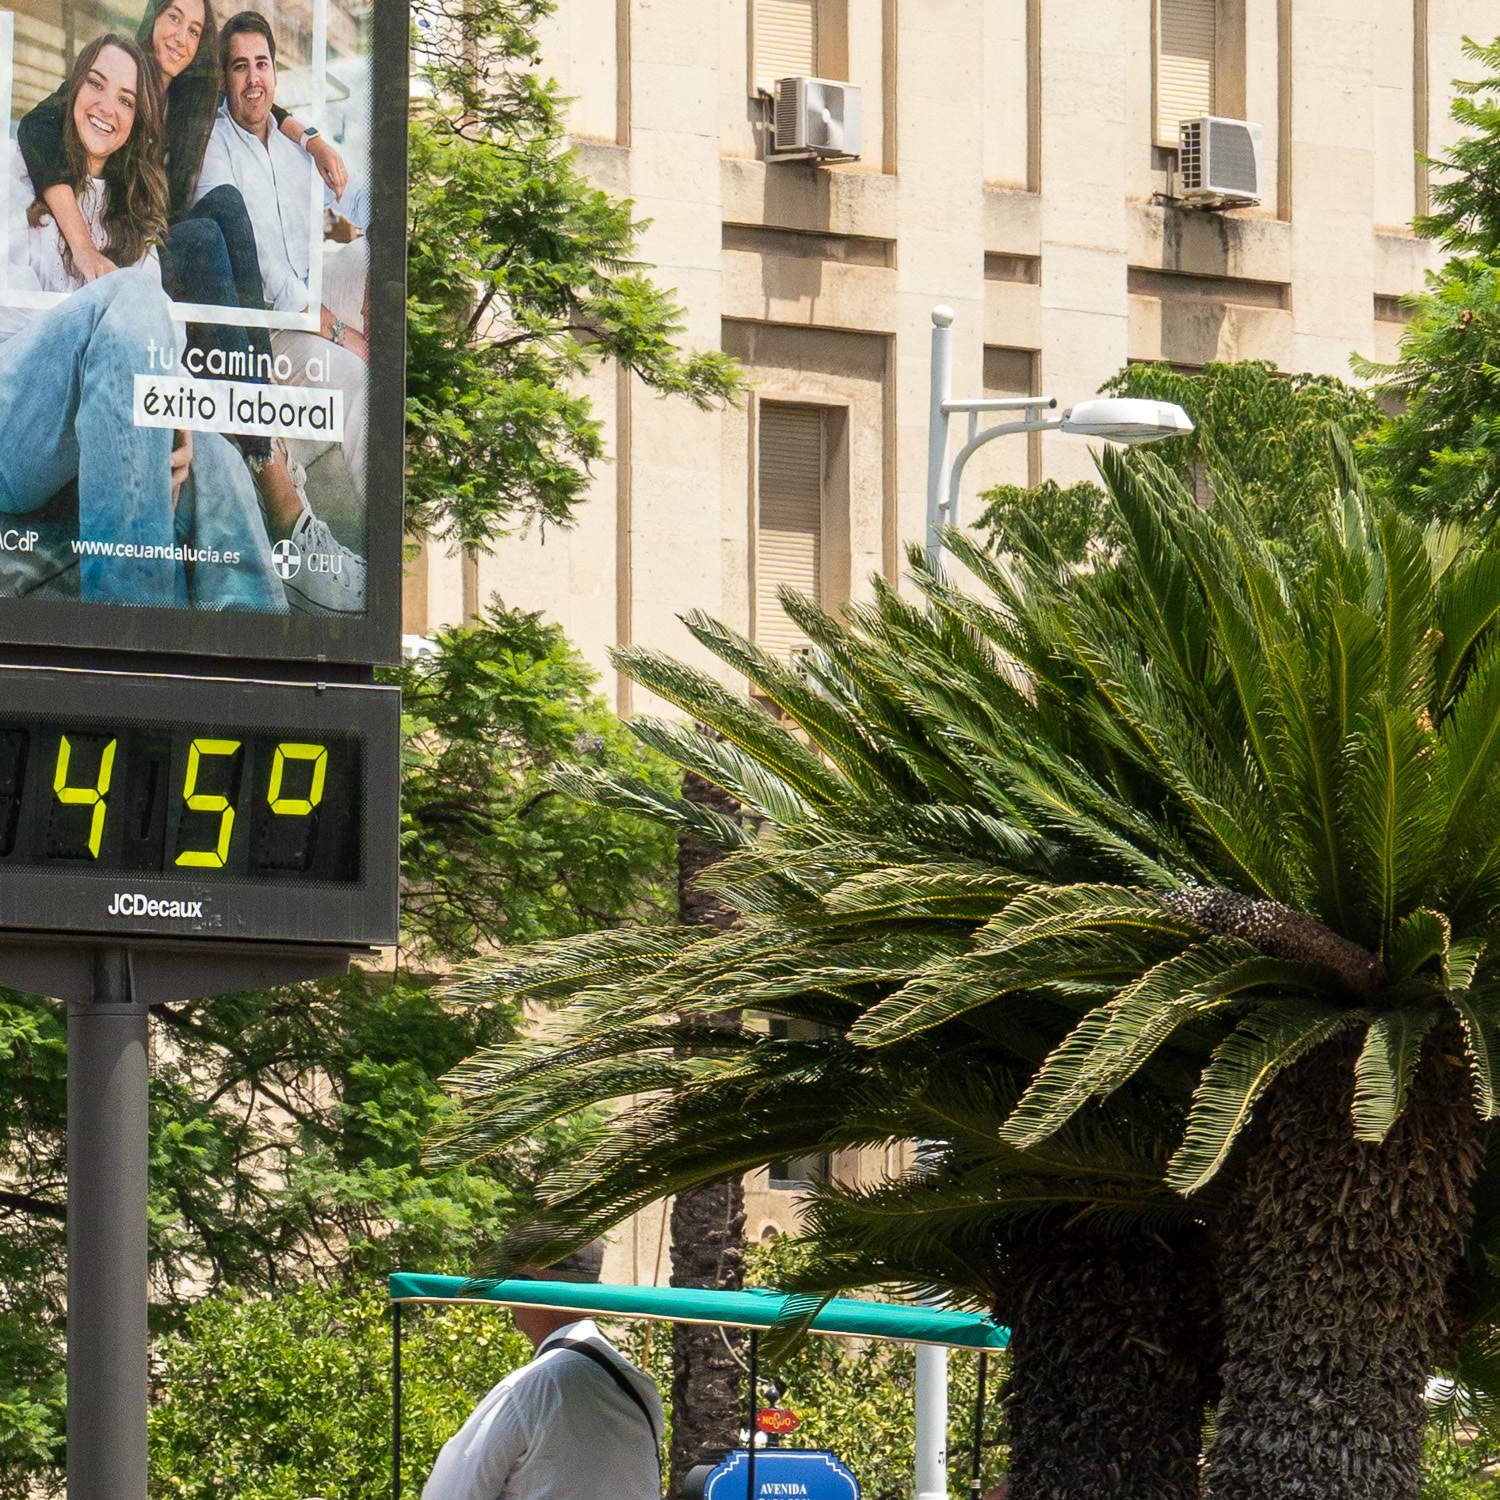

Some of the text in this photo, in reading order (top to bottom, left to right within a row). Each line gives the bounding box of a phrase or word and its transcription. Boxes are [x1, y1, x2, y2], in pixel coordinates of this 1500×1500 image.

[147, 339, 331, 382] tu camino al
[143, 386, 334, 430] éxito laboral
[71, 540, 241, 564] www.ceuandalucia.es
[307, 552, 343, 574] CEU
[108, 893, 203, 918] JCDecaux
[760, 1483, 807, 1495] AVENIDA
